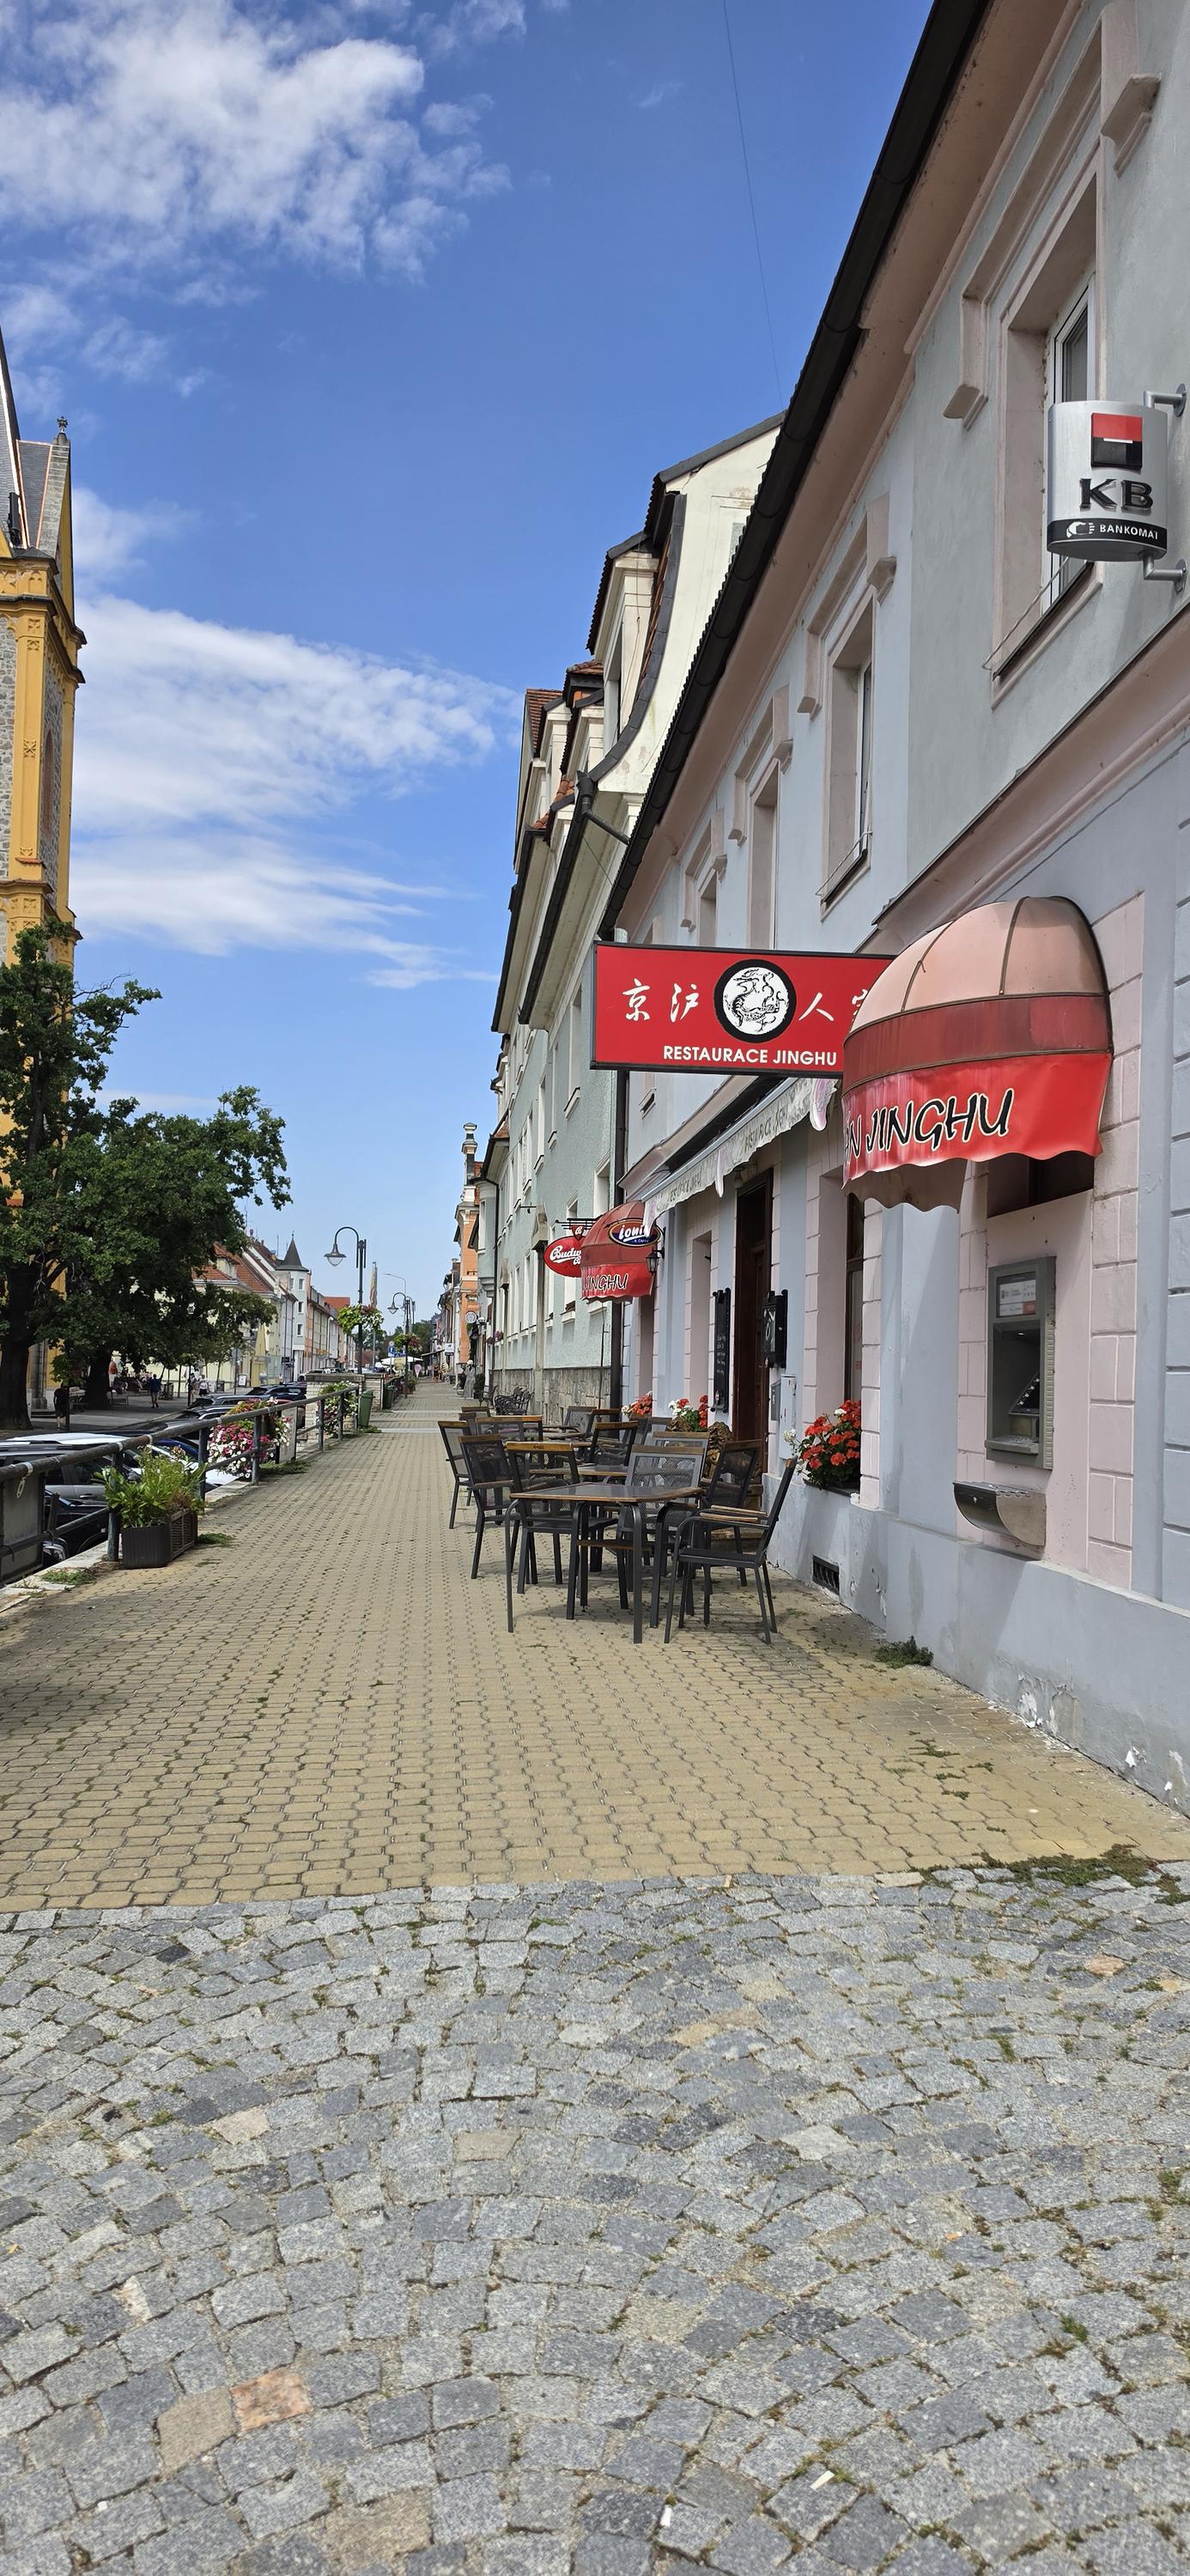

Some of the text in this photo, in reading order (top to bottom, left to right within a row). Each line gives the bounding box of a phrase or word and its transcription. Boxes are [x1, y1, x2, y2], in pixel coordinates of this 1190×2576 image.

[1079, 477, 1154, 510] KB
[1099, 524, 1159, 540] BANKOMAT
[663, 1045, 837, 1066] RESTAURACE JINGHU
[865, 1088, 1015, 1152] JINGHU
